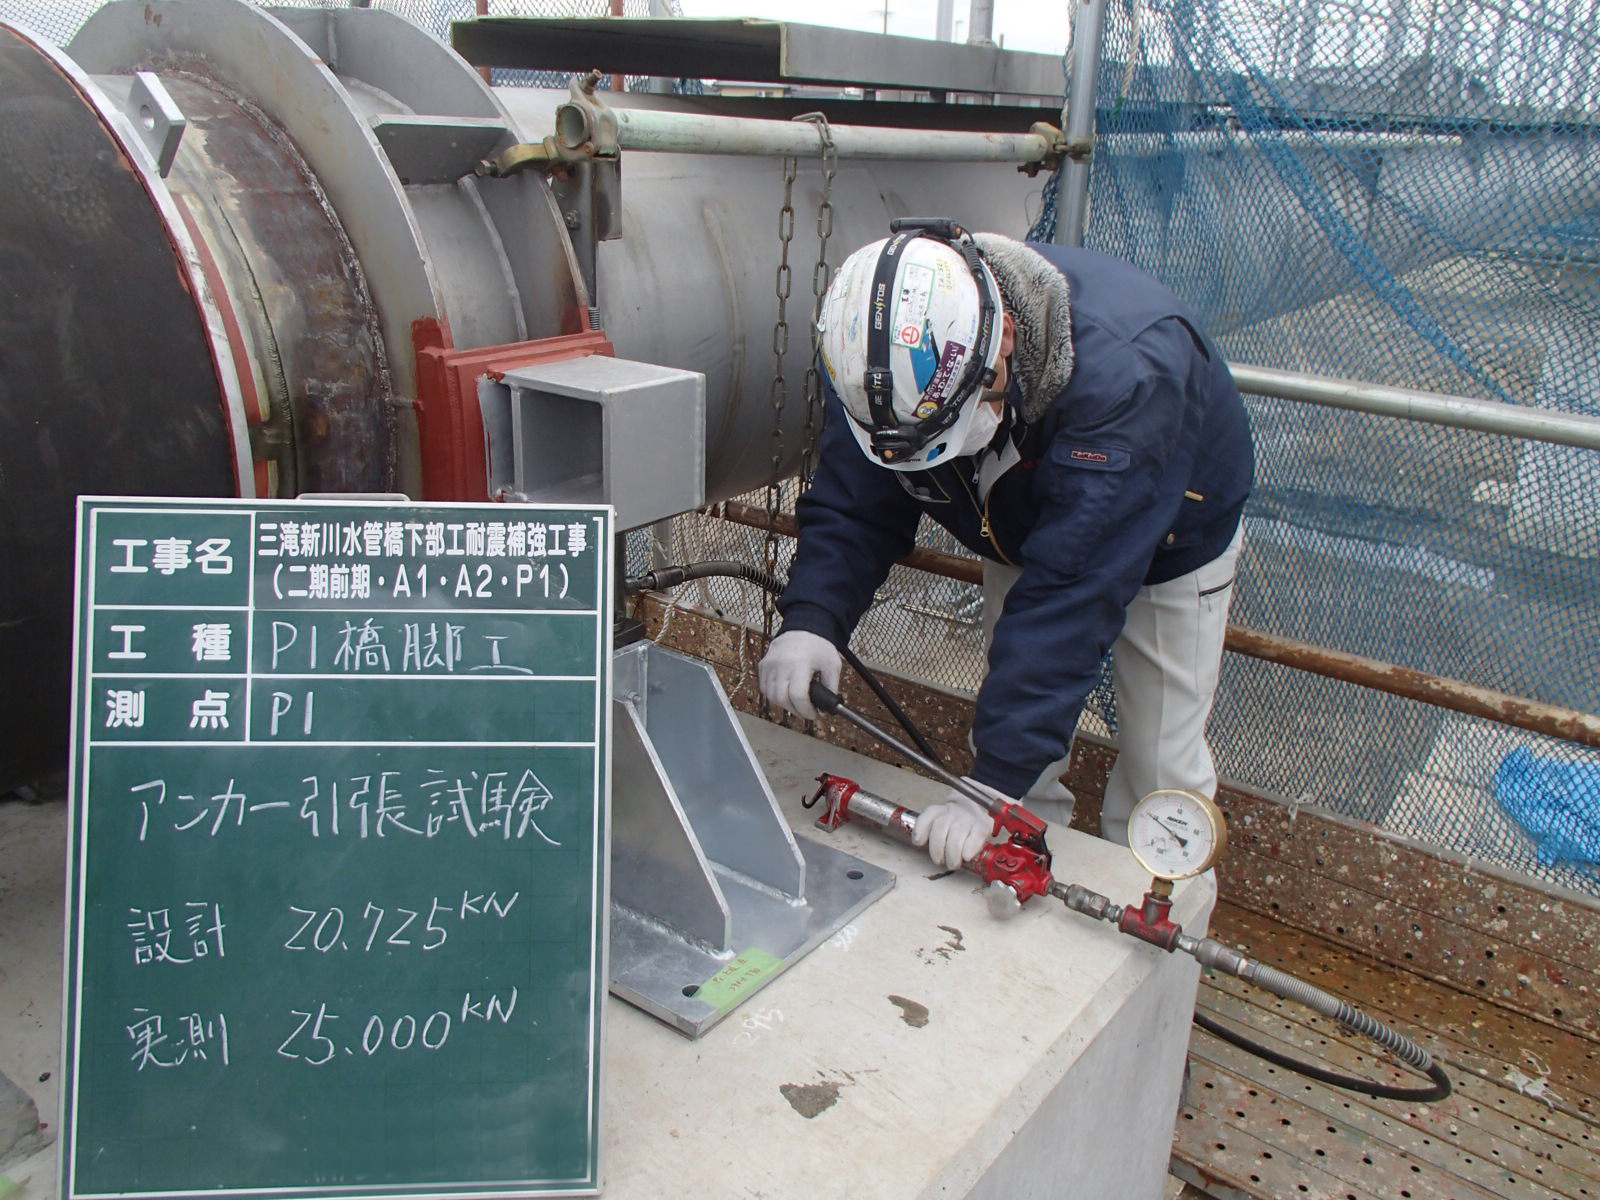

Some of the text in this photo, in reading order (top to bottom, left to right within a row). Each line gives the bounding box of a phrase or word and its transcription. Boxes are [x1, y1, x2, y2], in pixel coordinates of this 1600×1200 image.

[874, 283, 886, 330] GENTOS
[979, 312, 993, 356] GENTOS
[110, 536, 234, 576] 工事名
[257, 520, 588, 558] 三滝新川水管橋下部工耐震補強工事
[270, 691, 314, 736] P1
[131, 768, 562, 846] アンカー引張試験
[127, 901, 226, 965] 設計
[126, 1008, 230, 1071] 実測
